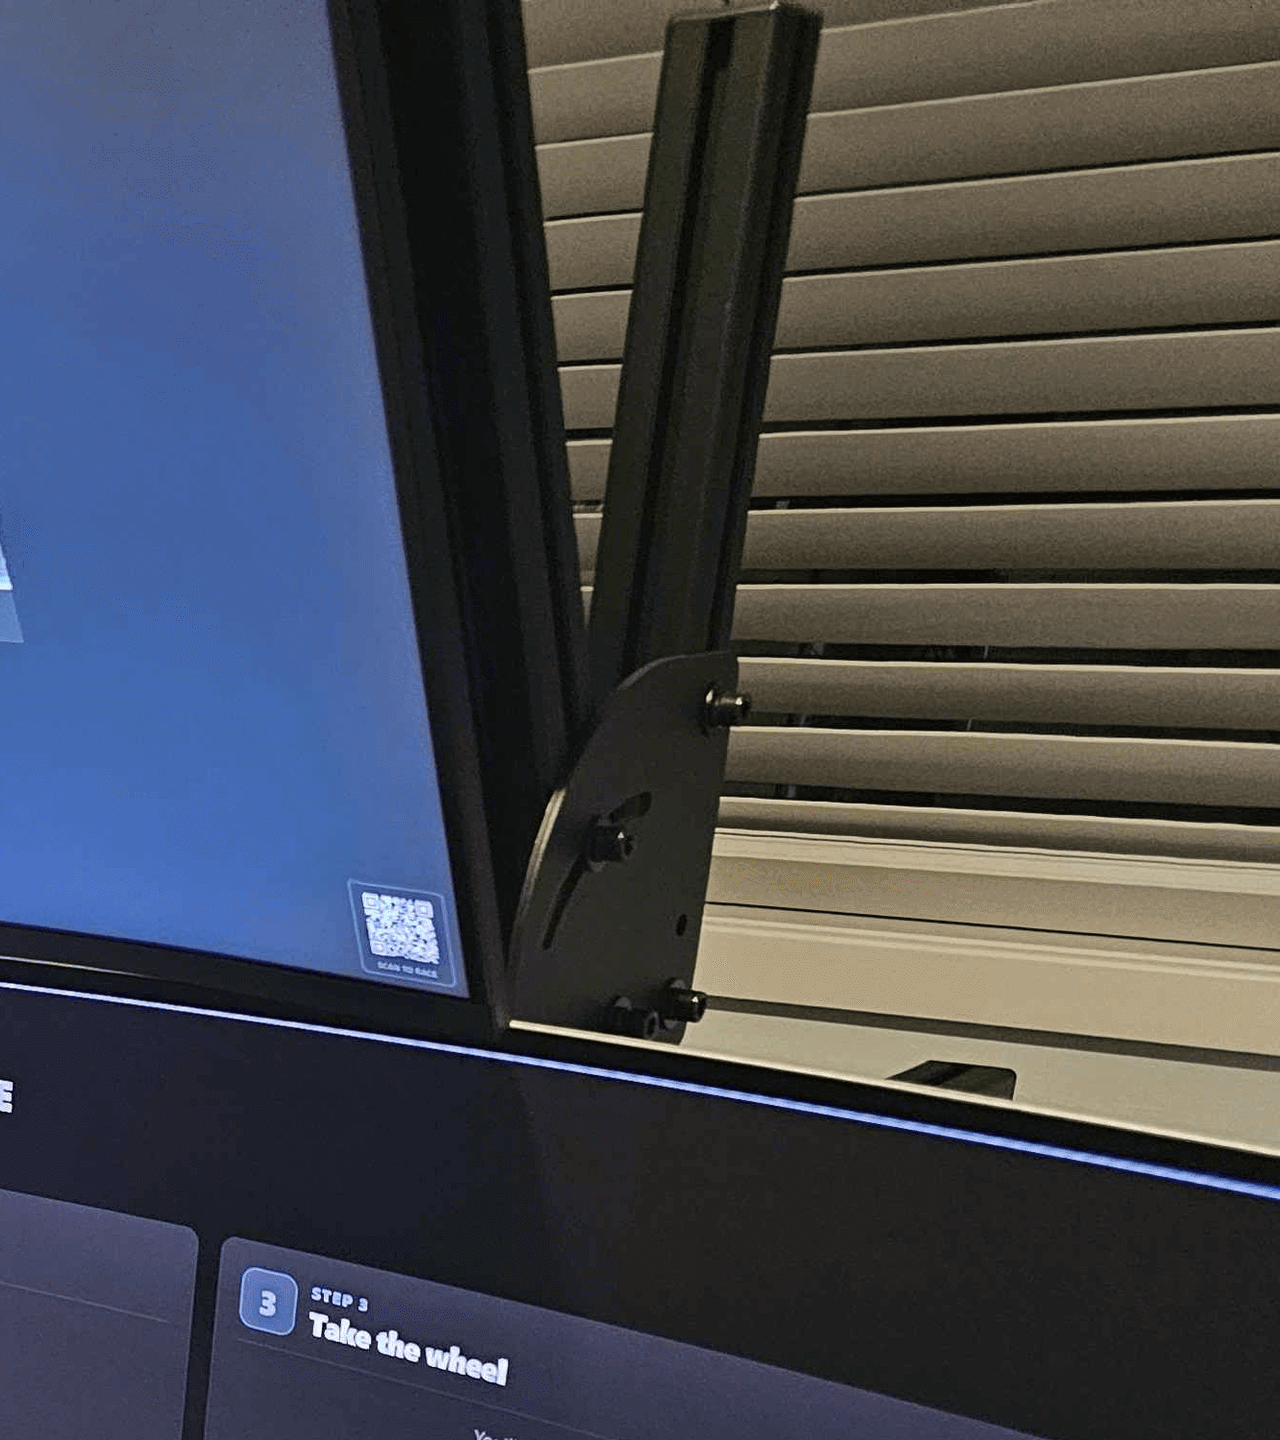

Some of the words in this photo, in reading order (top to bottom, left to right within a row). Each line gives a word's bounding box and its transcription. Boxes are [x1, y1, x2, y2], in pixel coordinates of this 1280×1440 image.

[258, 1290, 277, 1317] 3
[310, 1286, 354, 1308] STEP
[357, 1297, 369, 1312] 3
[308, 1311, 372, 1350] Take
[376, 1329, 421, 1363] the
[425, 1346, 509, 1387] wheel
